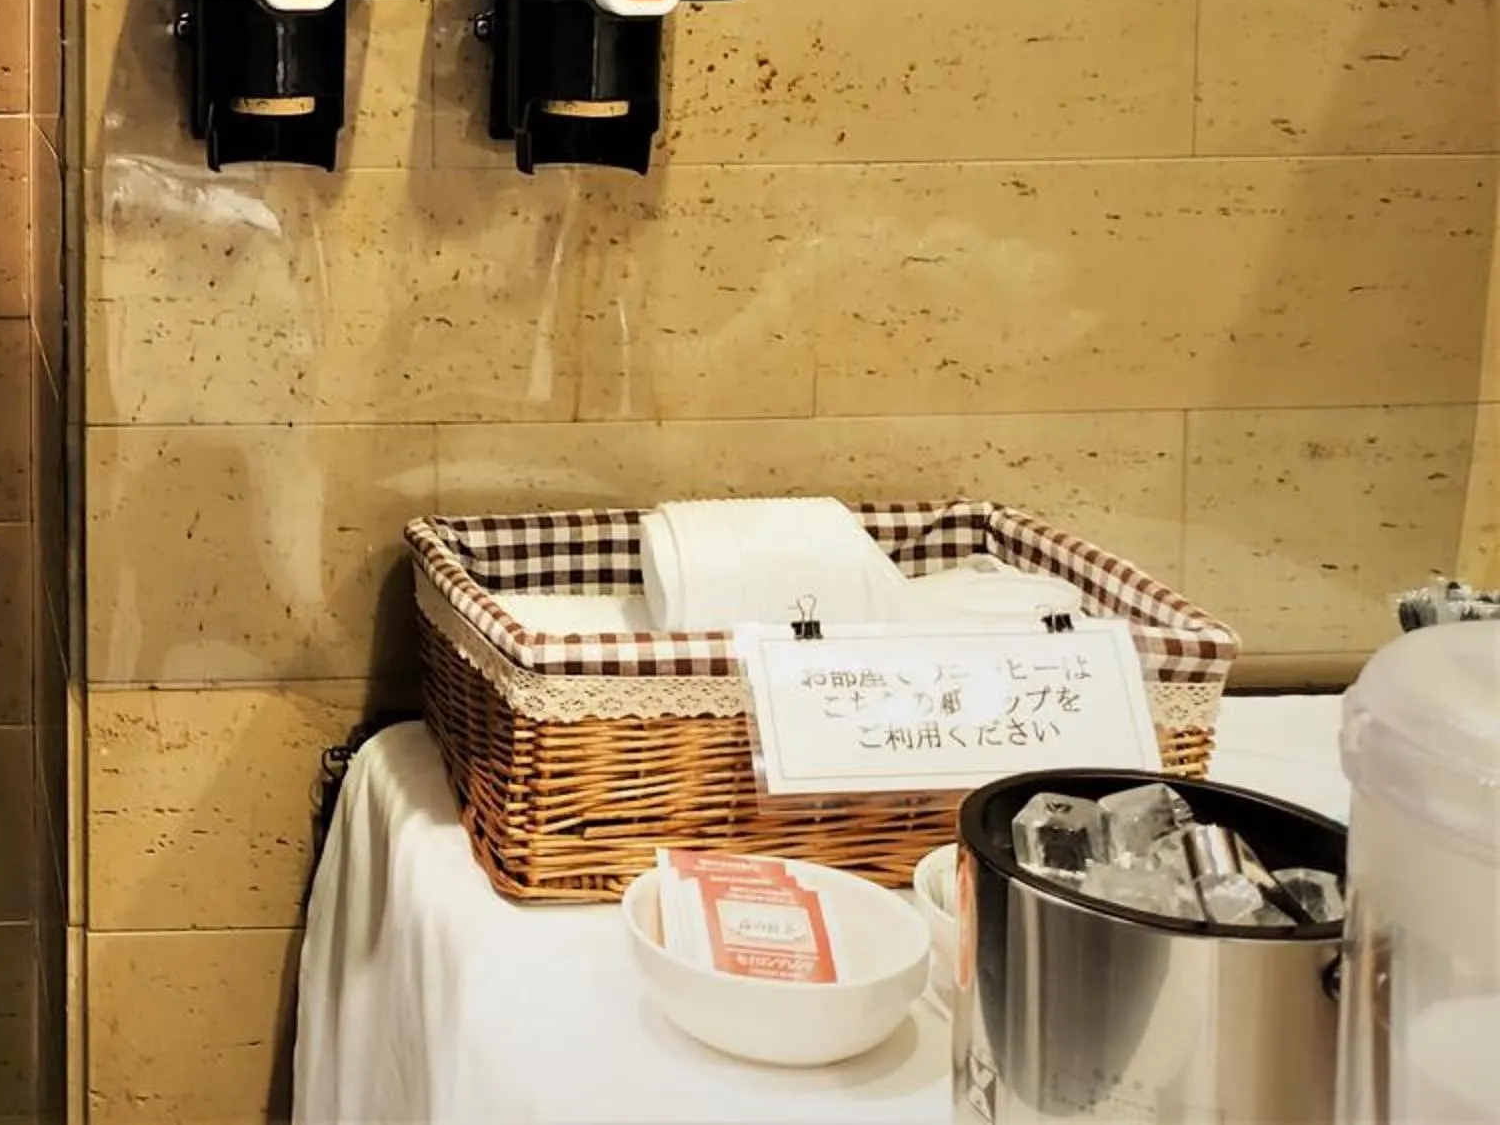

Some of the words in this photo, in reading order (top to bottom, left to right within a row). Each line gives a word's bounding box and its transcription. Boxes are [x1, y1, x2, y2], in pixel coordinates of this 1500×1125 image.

[857, 718, 1061, 752] ご利用ください
